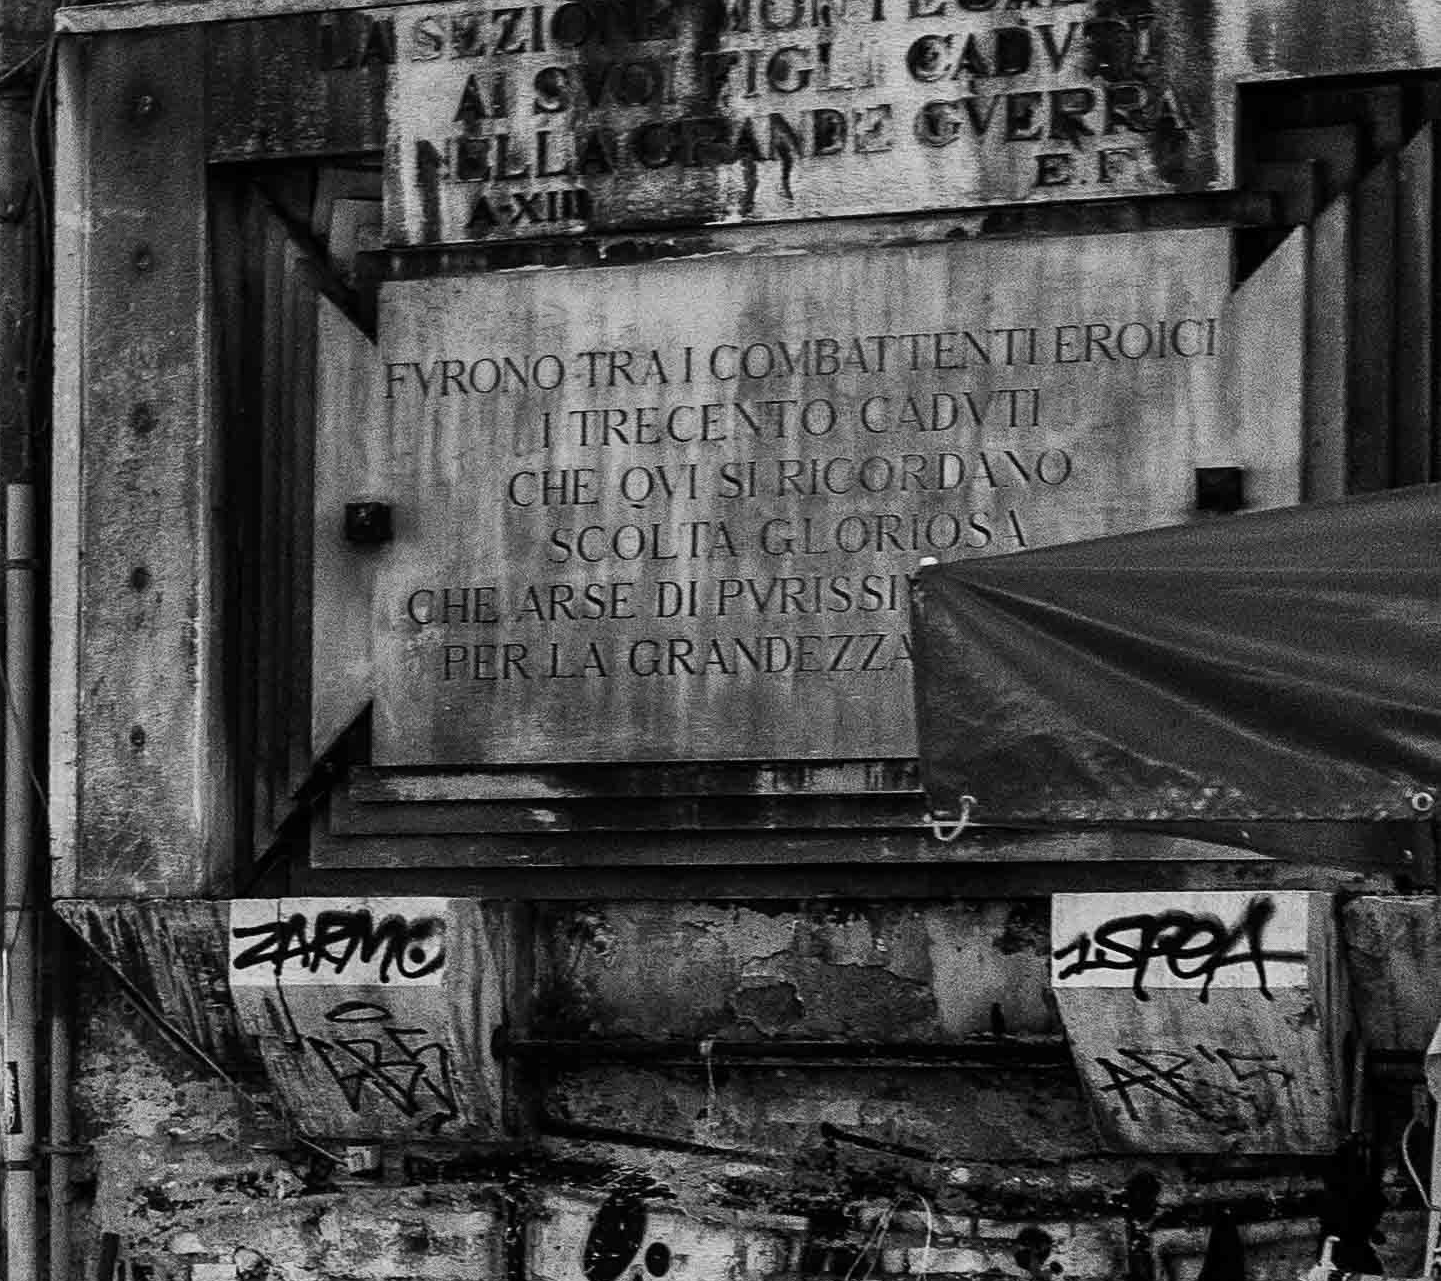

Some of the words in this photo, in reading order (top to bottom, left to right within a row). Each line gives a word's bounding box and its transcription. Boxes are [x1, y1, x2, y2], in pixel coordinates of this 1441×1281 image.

[384, 353, 566, 400] FVRONO
[576, 349, 670, 388] TRA
[682, 346, 694, 384] I
[708, 327, 1039, 381] COMBATTENTI
[1054, 318, 1220, 364] EROICI
[540, 411, 552, 450] I
[568, 398, 839, 447] TRECENTO
[860, 388, 1041, 435] CADVTI
[507, 467, 600, 508] CHE
[620, 463, 699, 510] QVI
[718, 460, 759, 499] SI
[777, 447, 1073, 499] RICORDANO
[548, 520, 740, 564] SCOLTA
[759, 508, 1030, 558] GLORIOSA
[405, 585, 500, 626] CHE
[519, 581, 637, 621] ARSE
[655, 579, 699, 620] DI
[716, 574, 914, 618] PVRISSI
[442, 643, 532, 681] PER
[550, 641, 608, 680] LA
